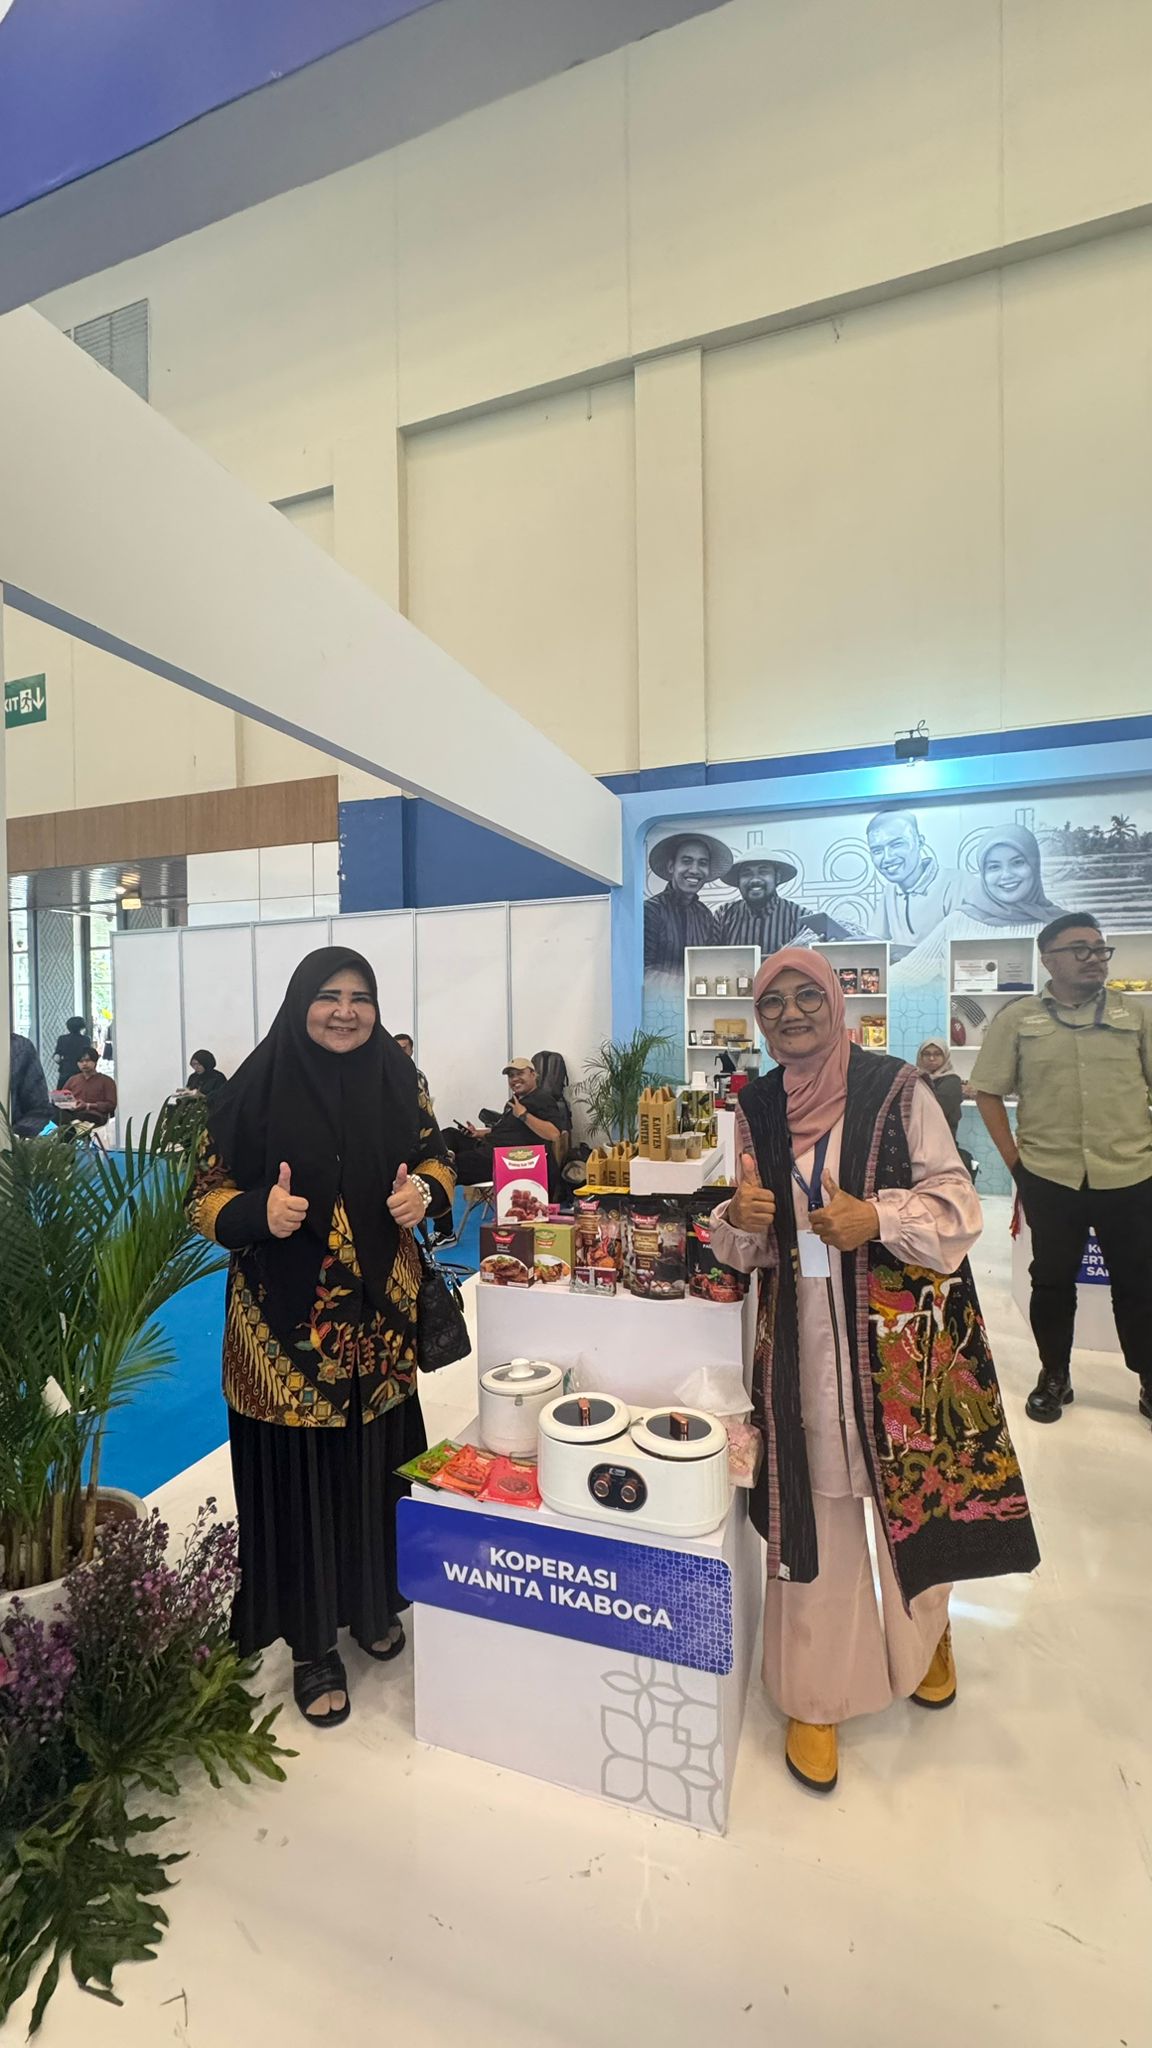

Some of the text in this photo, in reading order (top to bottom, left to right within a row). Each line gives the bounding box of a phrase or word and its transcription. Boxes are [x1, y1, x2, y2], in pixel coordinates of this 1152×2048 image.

[4, 697, 19, 712] XIT
[653, 1117, 661, 1150] KAPITEN
[1081, 1255, 1104, 1265] ERT
[490, 1547, 617, 1591] KOPERASI
[443, 1561, 673, 1630] WANITA IKABOGA
